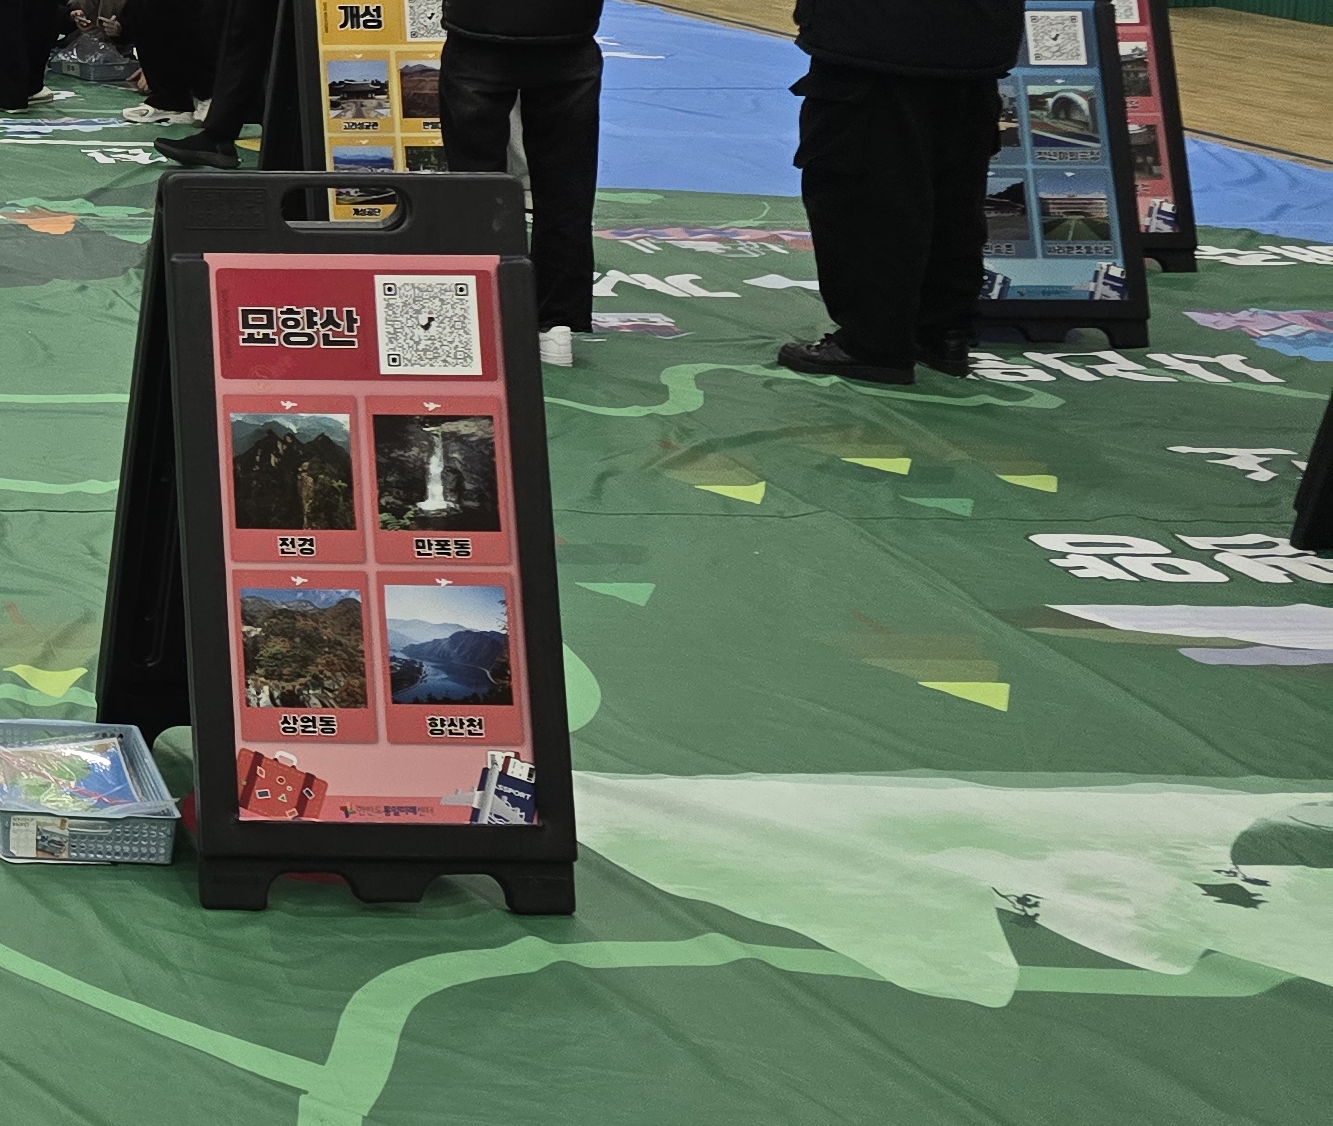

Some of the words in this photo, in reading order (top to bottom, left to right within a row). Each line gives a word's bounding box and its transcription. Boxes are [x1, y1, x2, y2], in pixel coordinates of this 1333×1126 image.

[337, 4, 383, 30] 개성
[235, 304, 360, 351] 묘향산
[276, 536, 317, 557] 전경
[412, 537, 473, 559] 만폭동
[278, 713, 338, 736] 상원동
[425, 715, 486, 738] 향산천
